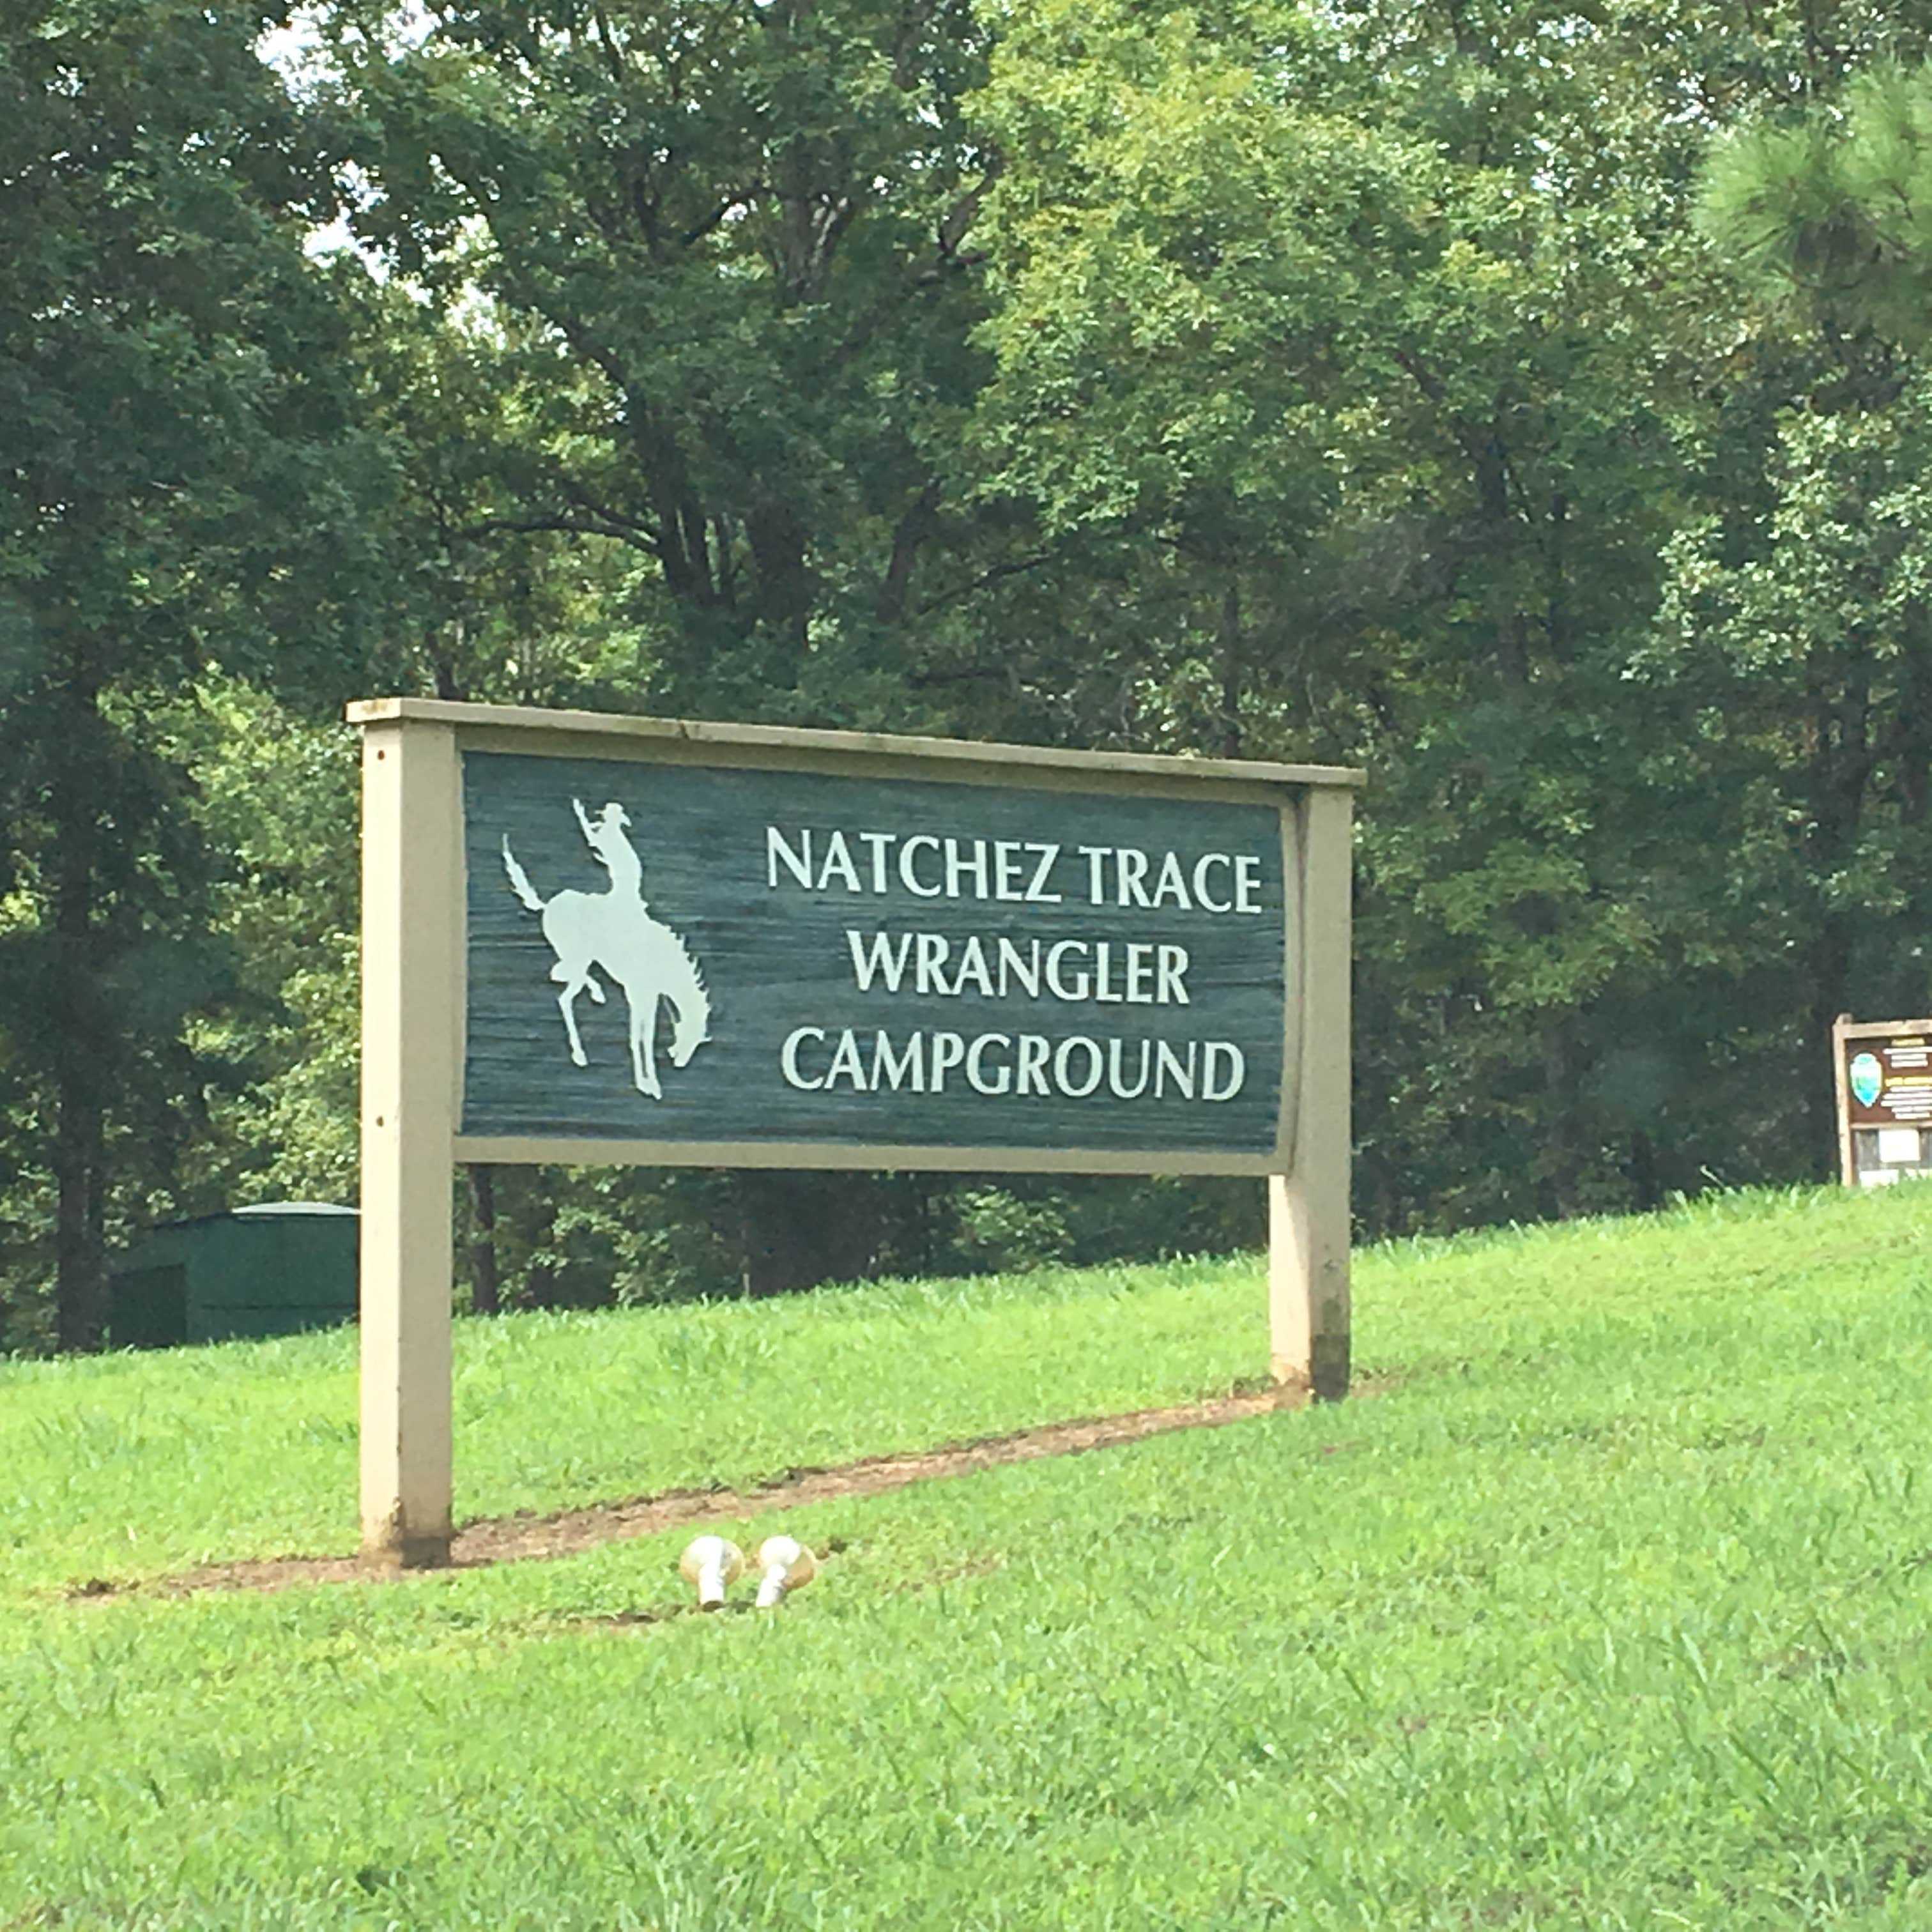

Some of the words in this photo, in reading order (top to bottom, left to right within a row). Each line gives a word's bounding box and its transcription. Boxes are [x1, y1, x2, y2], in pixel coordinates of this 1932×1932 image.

[767, 826, 1062, 903] NATCHEZ
[1078, 845, 1262, 914] TRACE
[845, 930, 1190, 1004] WRANGLER
[781, 1026, 1245, 1101] CAMPGROUND
